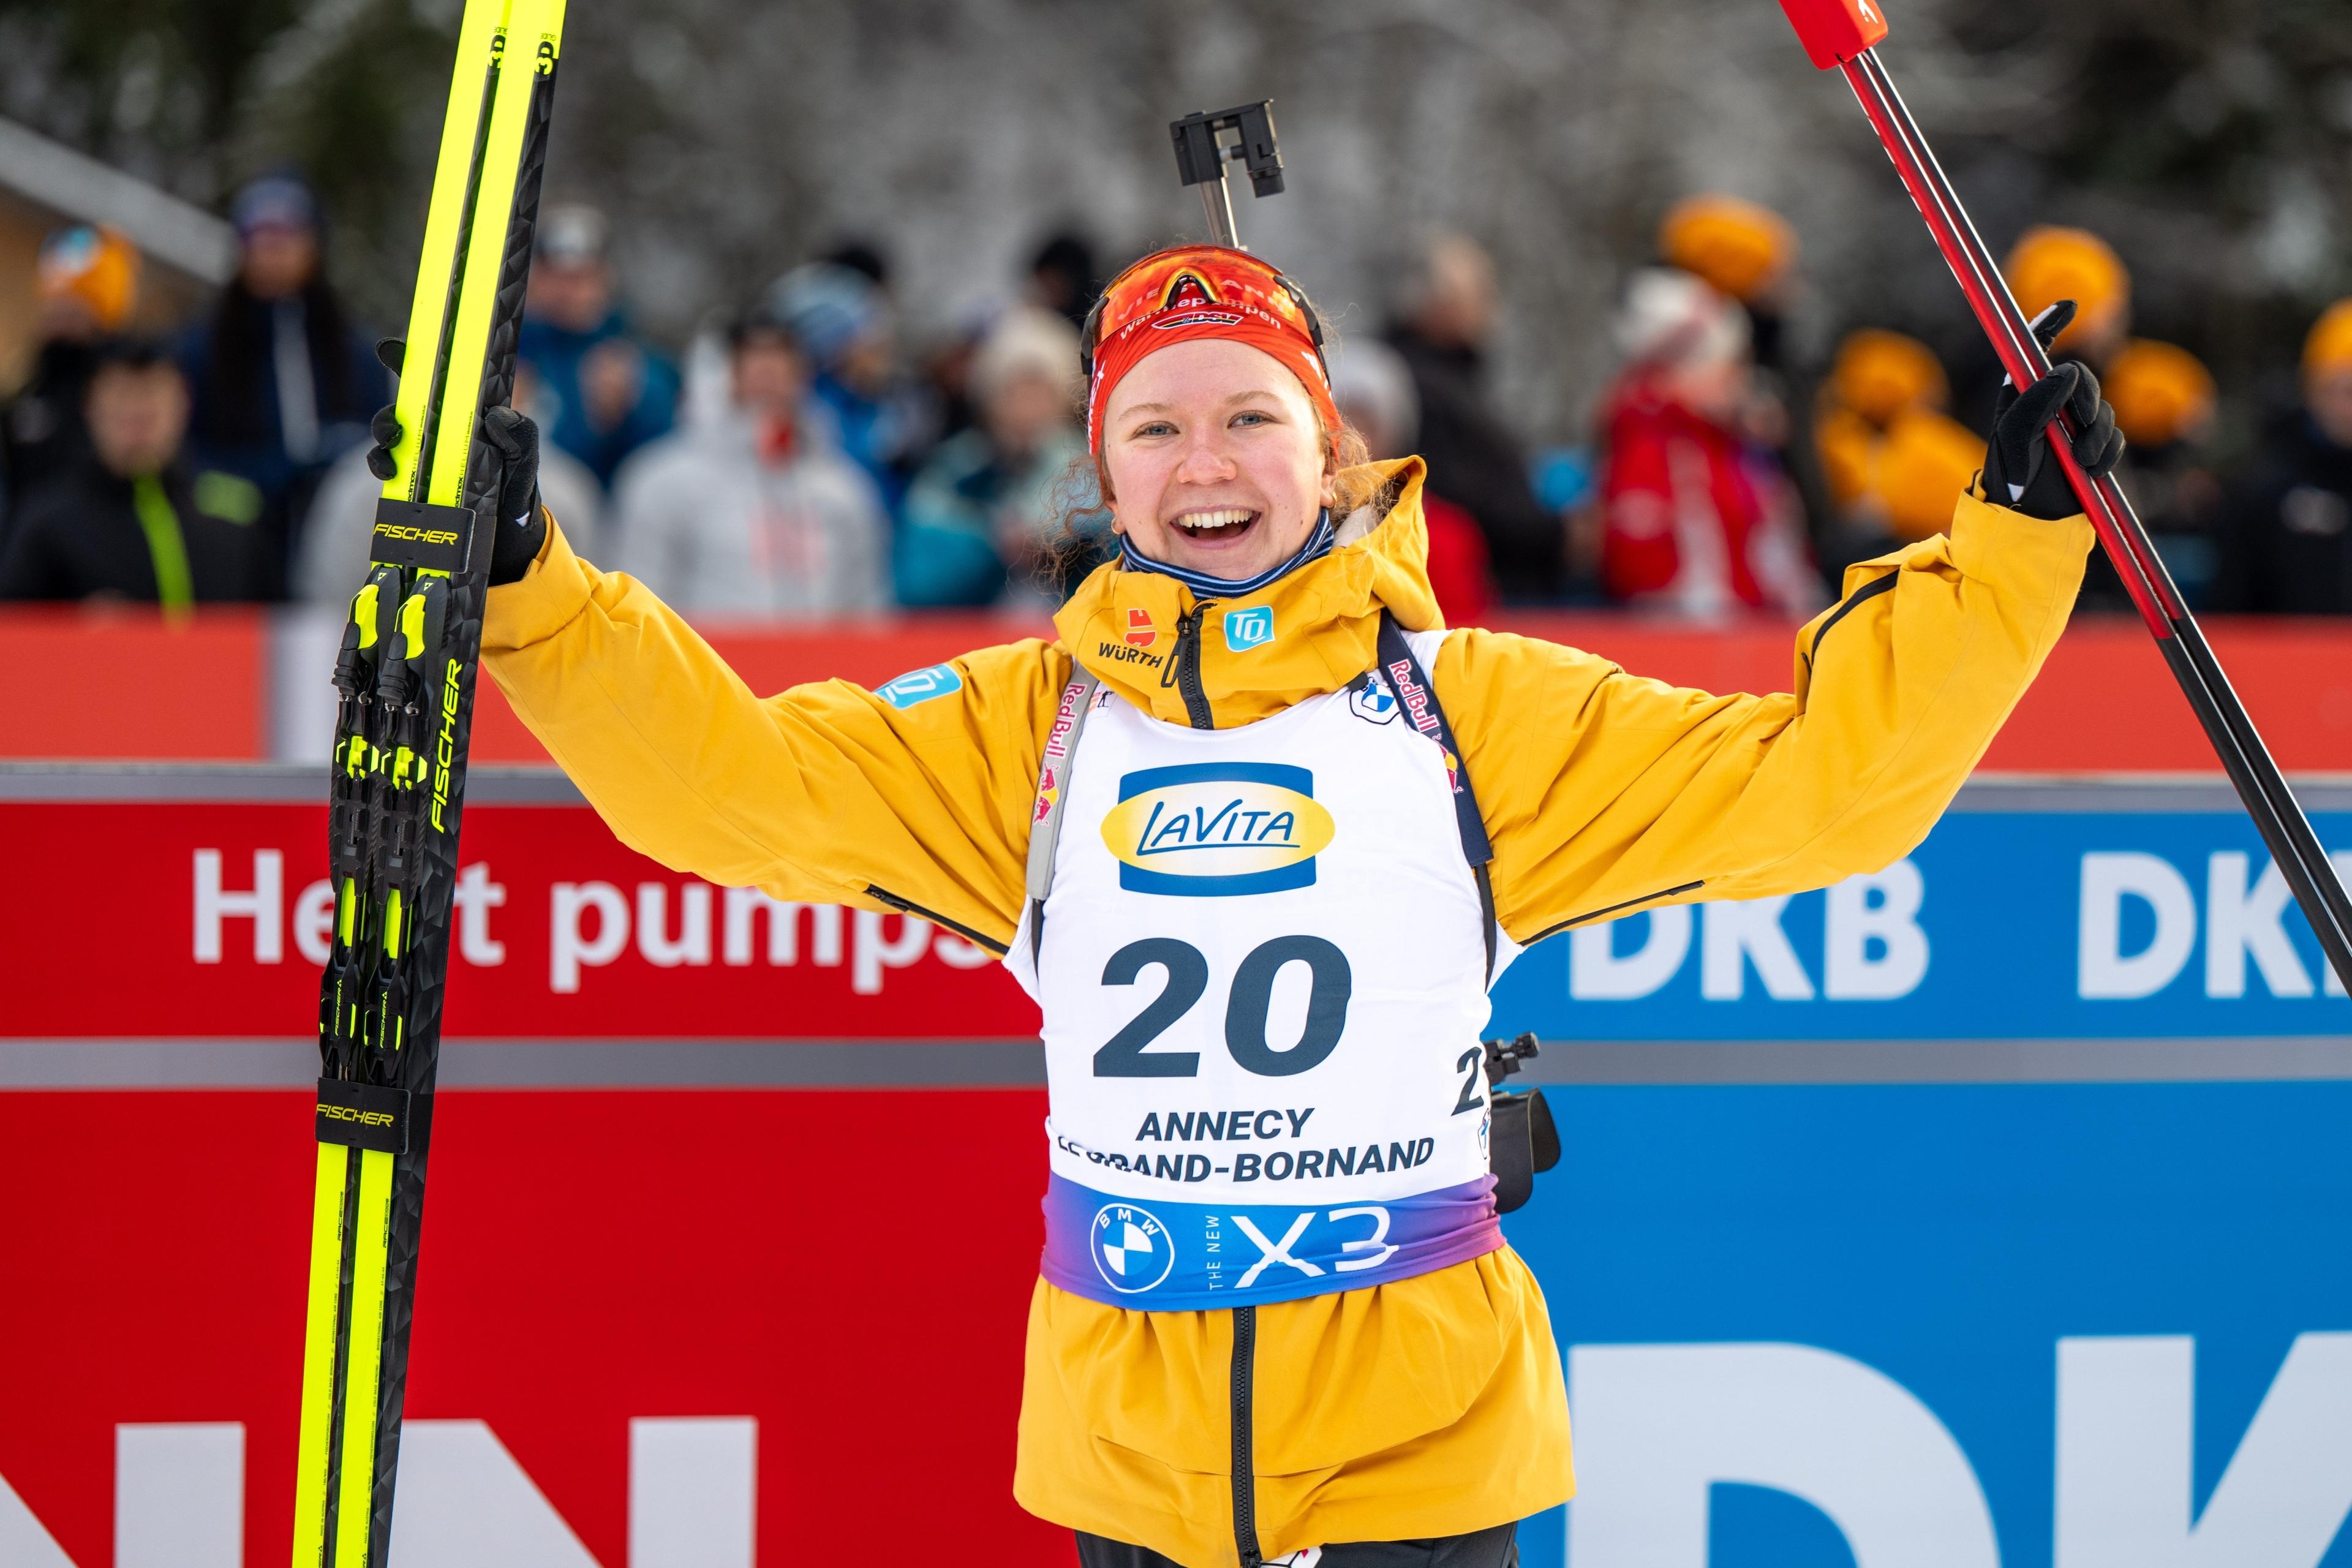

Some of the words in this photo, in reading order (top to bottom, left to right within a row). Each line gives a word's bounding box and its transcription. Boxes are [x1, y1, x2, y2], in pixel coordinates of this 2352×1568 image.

[488, 35, 506, 69] 3D
[535, 41, 554, 75] 3D
[373, 523, 459, 546] FISCHER
[1098, 642, 1164, 668] WÜRTH
[431, 658, 462, 834] FISCHER
[190, 848, 507, 968] Het
[2077, 851, 2352, 1000] DK
[1093, 934, 1352, 1077] 20
[379, 998, 388, 1049] FISCHER
[316, 1104, 394, 1128] FISCHER
[1135, 1107, 1316, 1142] ANNECY
[1098, 1208, 1161, 1237] BMW
[1205, 1215, 1221, 1253] NEW
[1231, 1206, 1400, 1289] X3
[1205, 1261, 1224, 1291] THE
